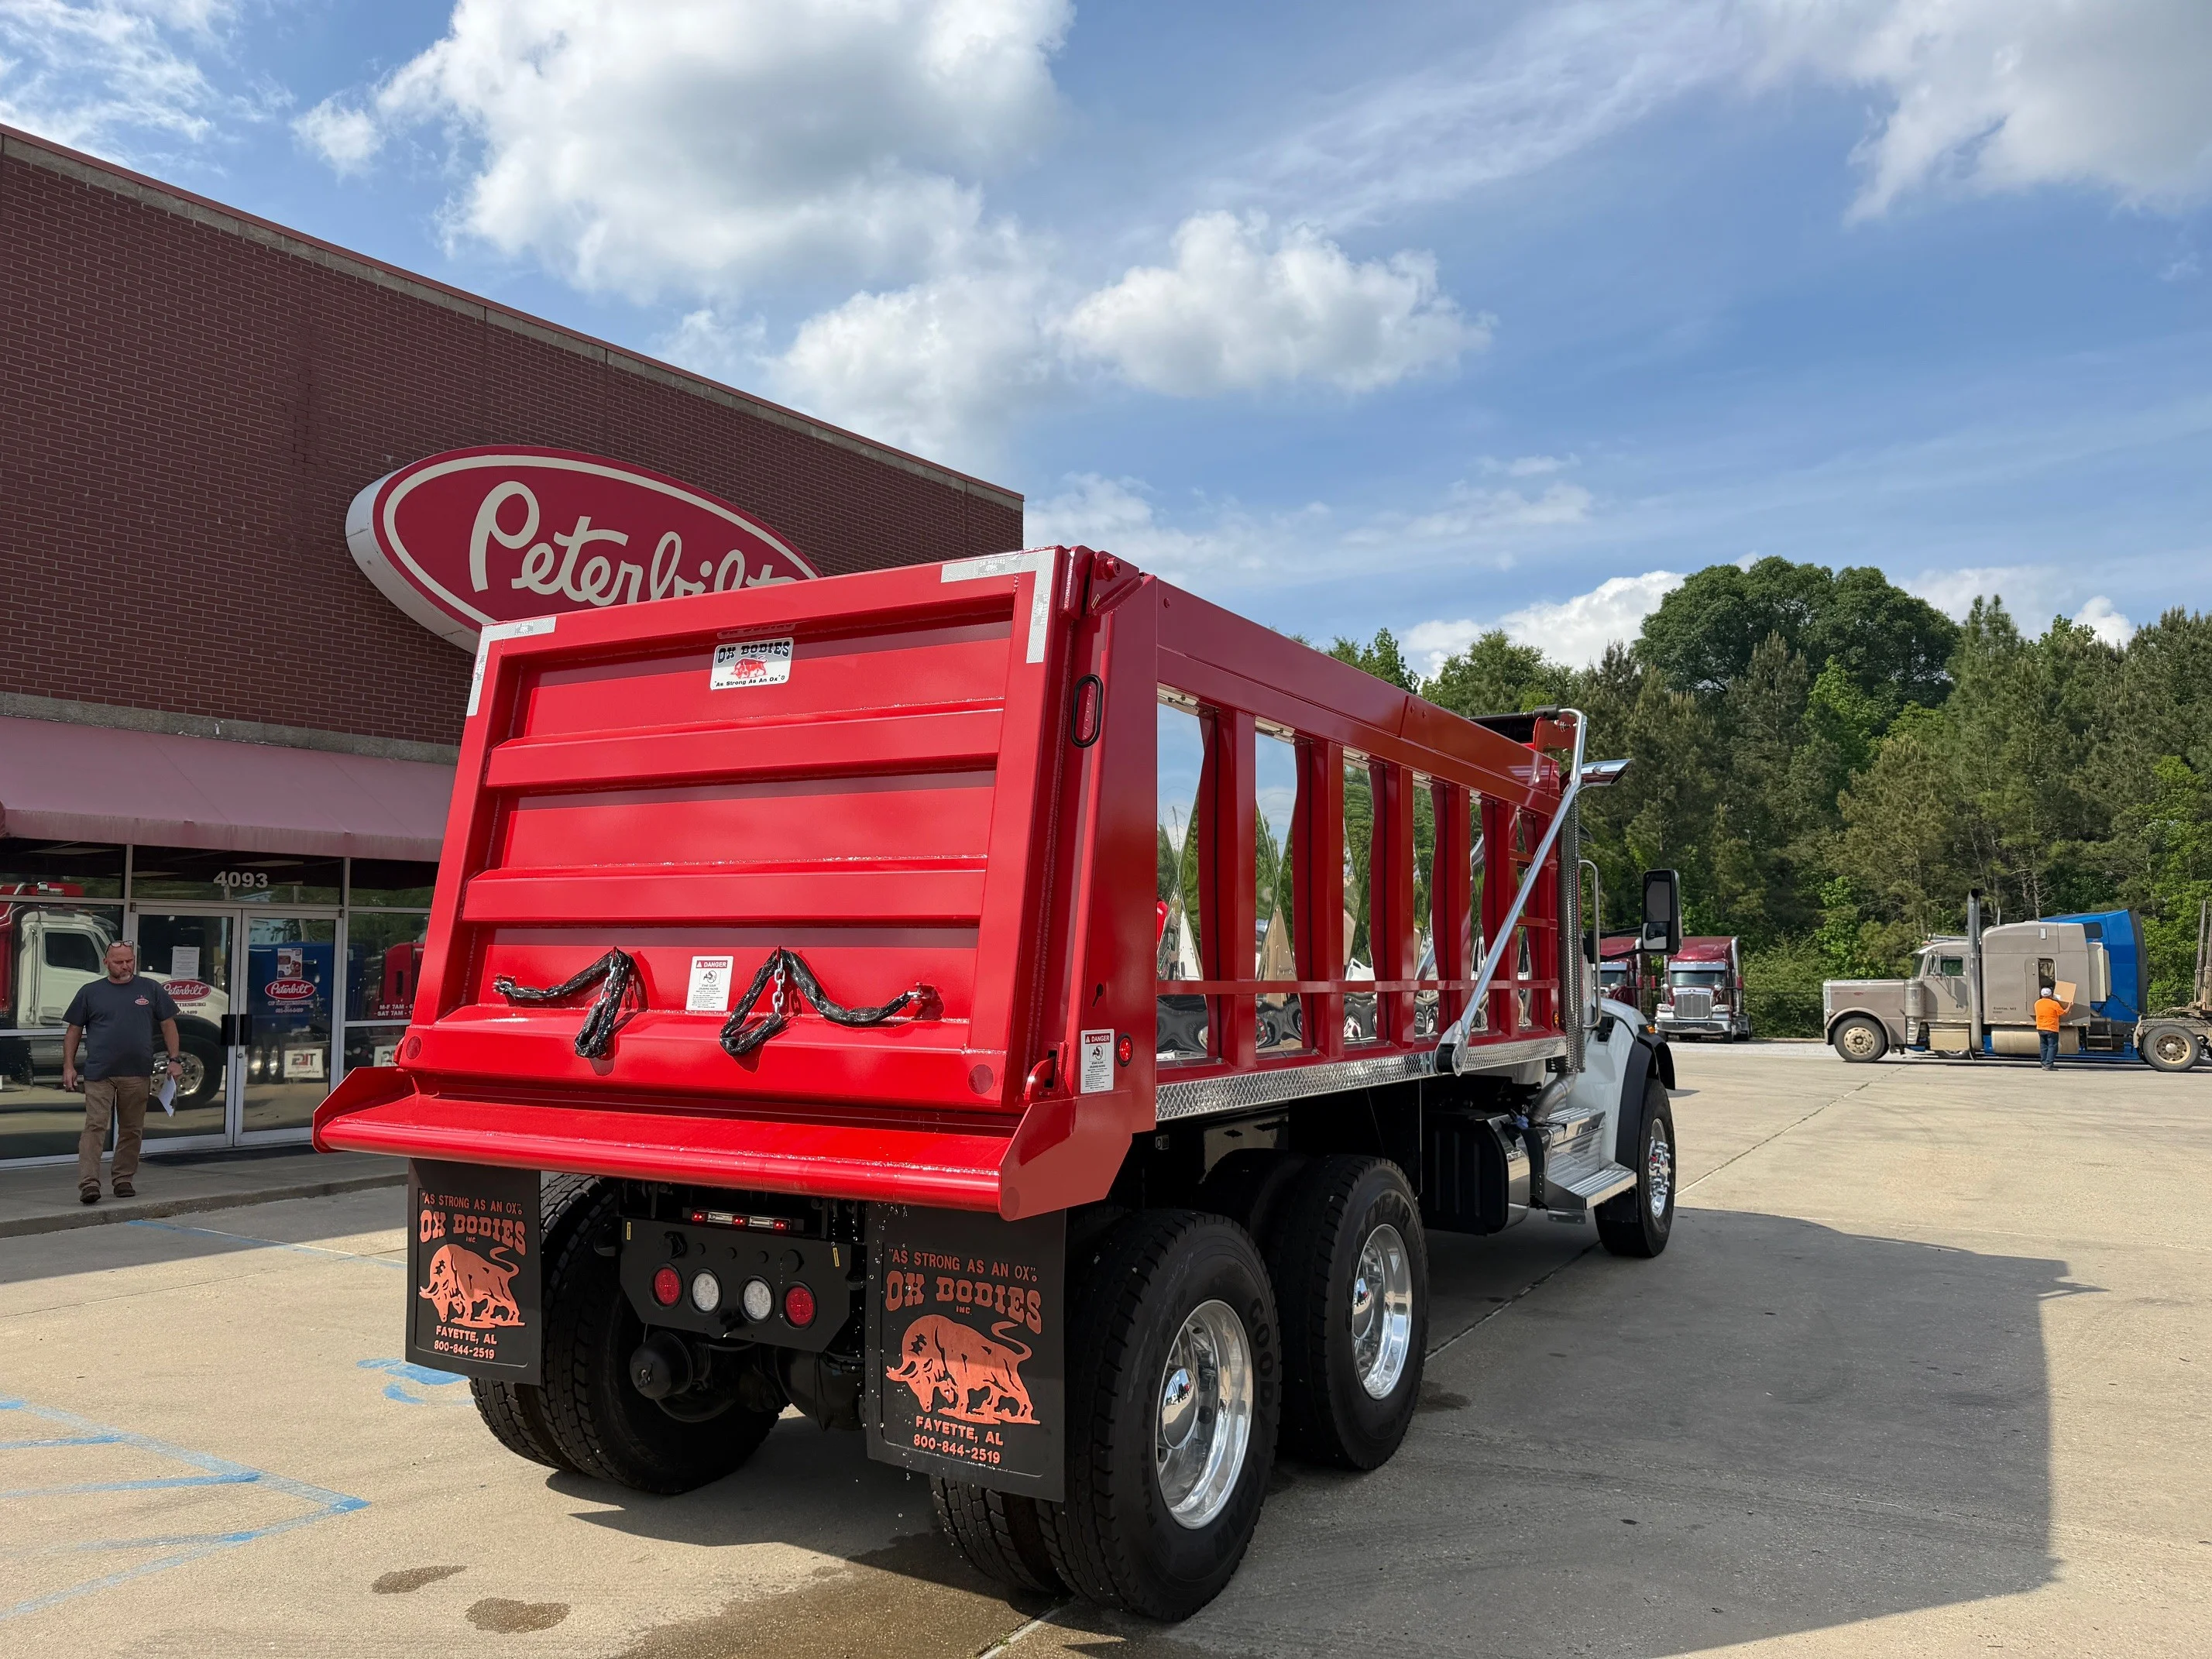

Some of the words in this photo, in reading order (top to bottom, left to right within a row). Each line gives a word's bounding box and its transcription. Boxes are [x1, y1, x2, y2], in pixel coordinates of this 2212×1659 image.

[717, 647, 737, 664] OX
[741, 641, 790, 657] BODIES
[214, 871, 268, 888] 4093
[270, 982, 311, 995] Peterbilt
[438, 1194, 469, 1208] STRONG
[474, 1198, 486, 1211] AS
[490, 1200, 503, 1213] AN
[420, 1209, 446, 1243] OX
[453, 1214, 526, 1256] BODIES
[914, 1251, 960, 1271] STRONG
[967, 1259, 984, 1274] AS
[991, 1261, 1009, 1277] AN
[884, 1270, 926, 1311] OX
[936, 1276, 1042, 1334] BODIES
[435, 1325, 479, 1345] FAYETTE,
[483, 1333, 498, 1345] AL
[434, 1340, 495, 1360] 800-844-2519
[915, 1415, 978, 1444] FAYETTE,
[984, 1431, 1004, 1446] AL
[913, 1434, 1001, 1464] 800-844-2519
